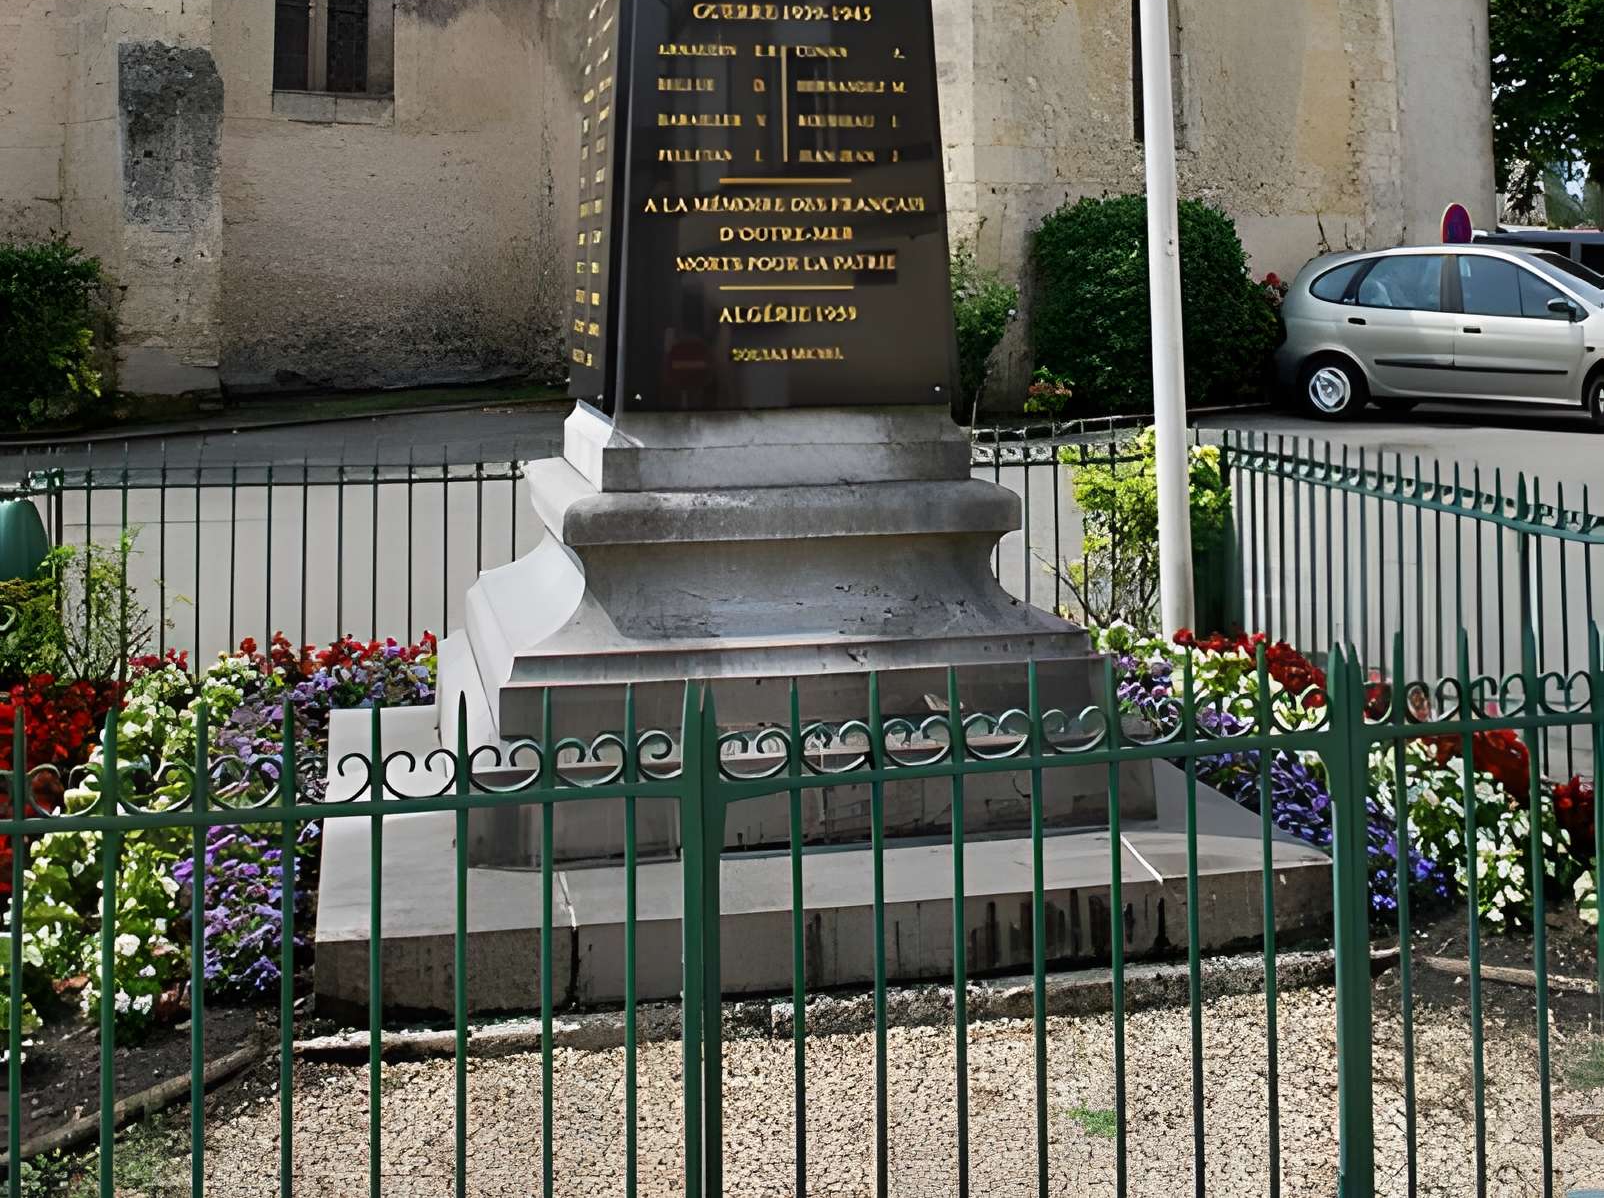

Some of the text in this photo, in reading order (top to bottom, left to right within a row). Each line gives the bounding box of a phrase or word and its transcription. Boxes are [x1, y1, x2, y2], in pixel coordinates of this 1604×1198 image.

[644, 198, 658, 213] A
[663, 197, 688, 213] LA
[747, 256, 799, 272] POUR
[804, 256, 828, 272] LA
[719, 304, 812, 323] ALGÉRIE
